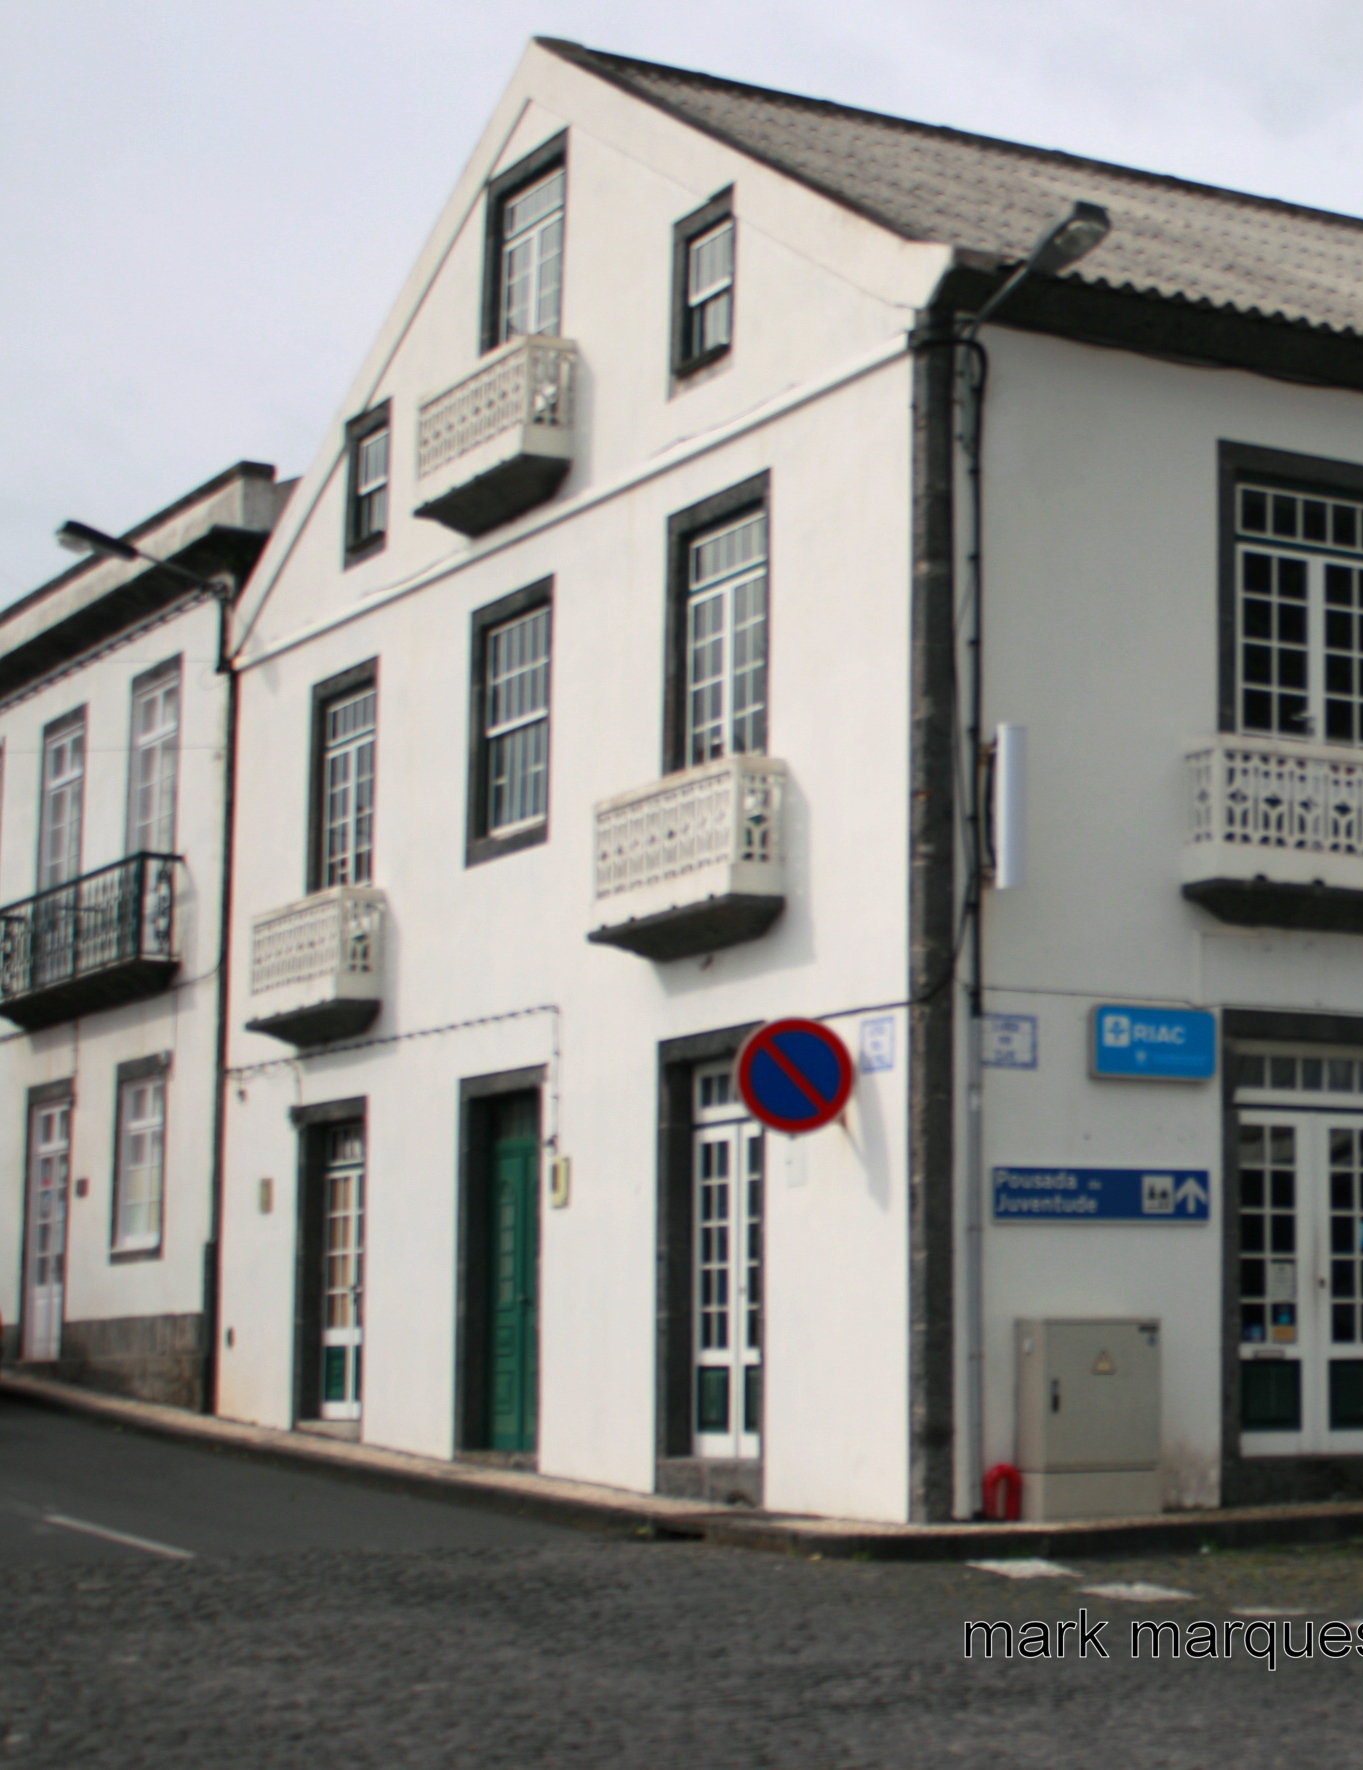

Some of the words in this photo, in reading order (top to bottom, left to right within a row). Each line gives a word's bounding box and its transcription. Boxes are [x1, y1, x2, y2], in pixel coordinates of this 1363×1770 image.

[1133, 1023, 1186, 1045] RIAC
[994, 1170, 1077, 1190] Pousada
[995, 1192, 1098, 1213] Juventude
